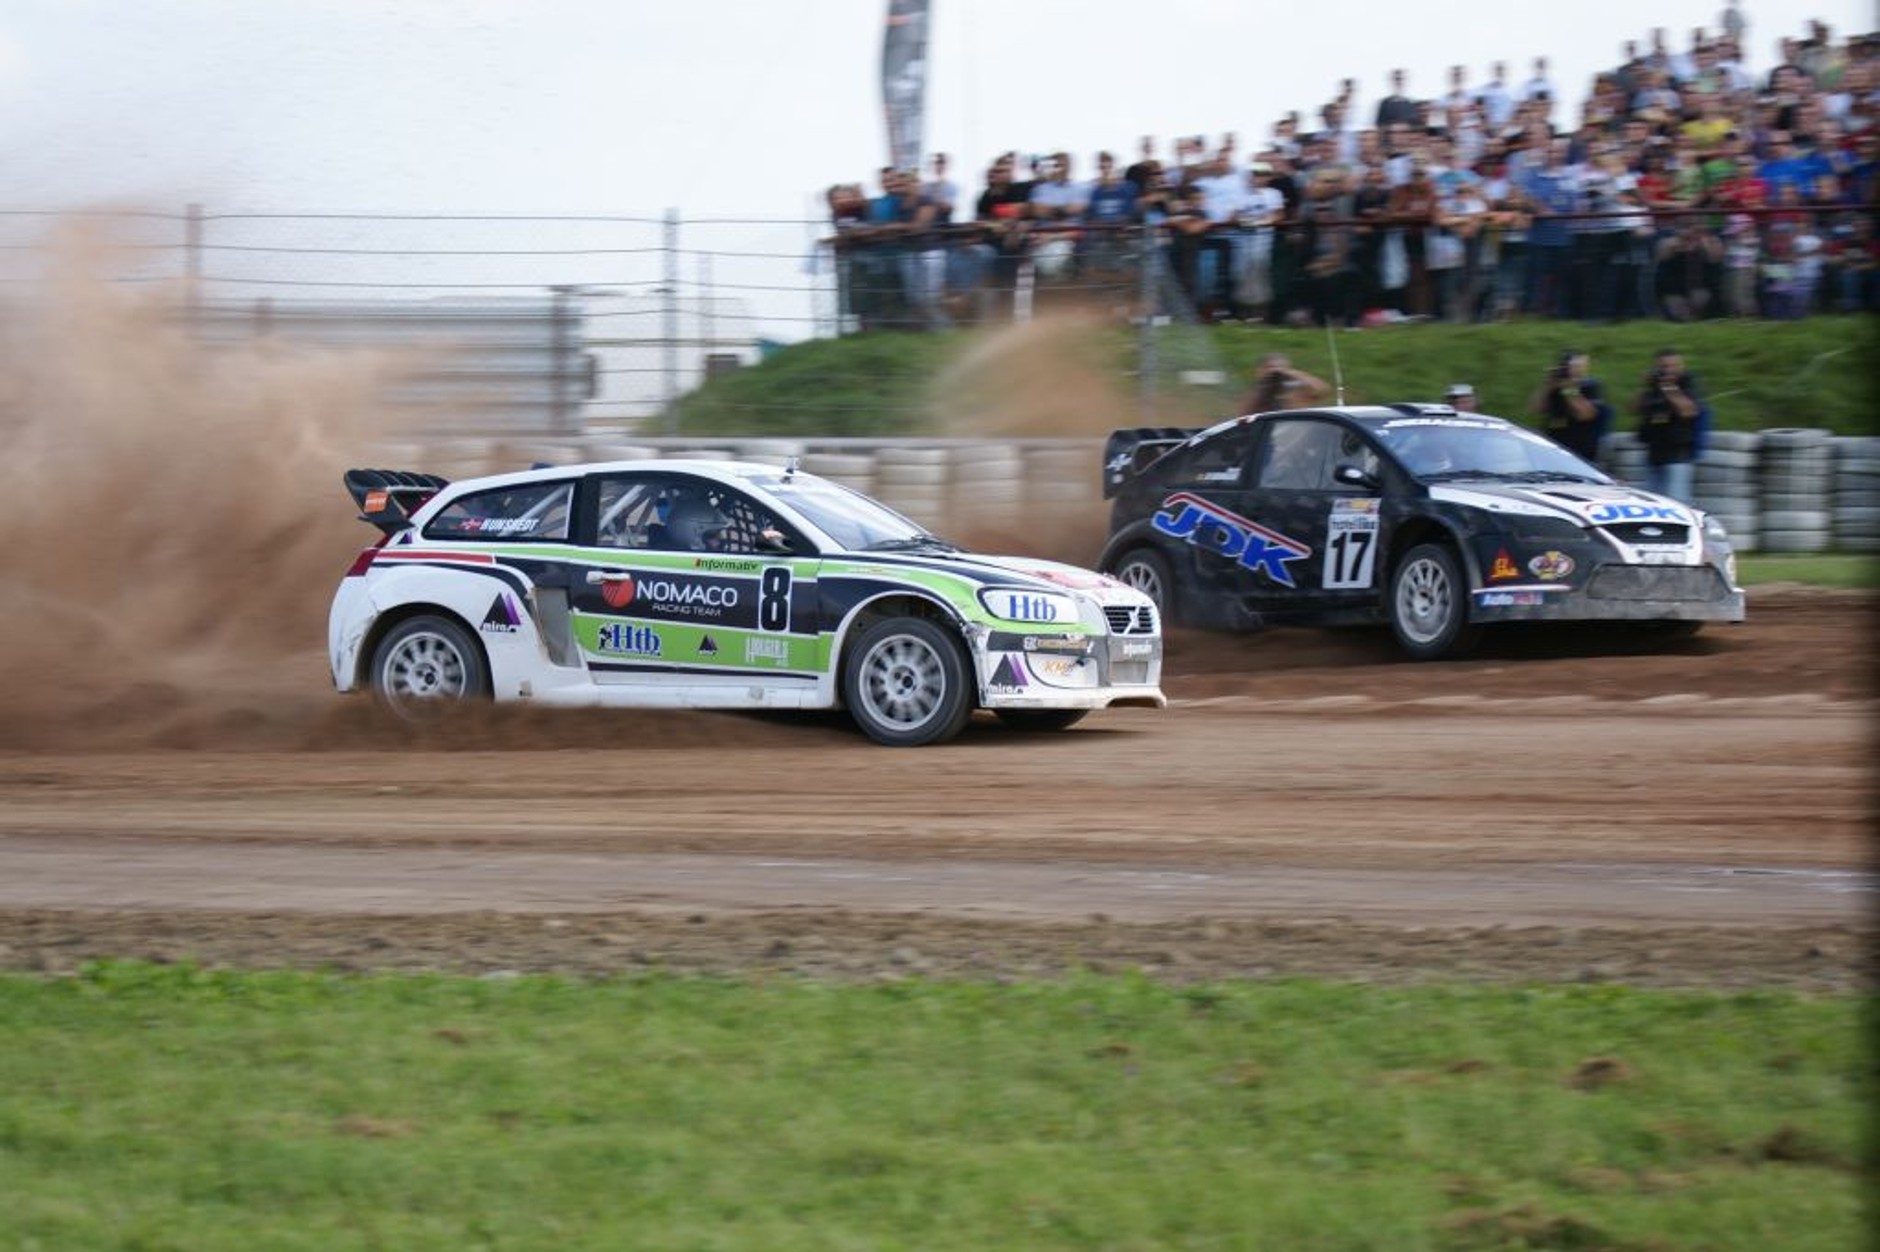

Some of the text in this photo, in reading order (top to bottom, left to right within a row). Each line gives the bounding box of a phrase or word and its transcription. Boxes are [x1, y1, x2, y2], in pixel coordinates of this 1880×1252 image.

[1590, 504, 1690, 521] JDK
[1151, 496, 1312, 588] JDK
[1331, 532, 1371, 582] 17
[637, 580, 738, 607] NOMACO
[652, 603, 721, 617] RACING TEAM
[760, 567, 791, 631] 8
